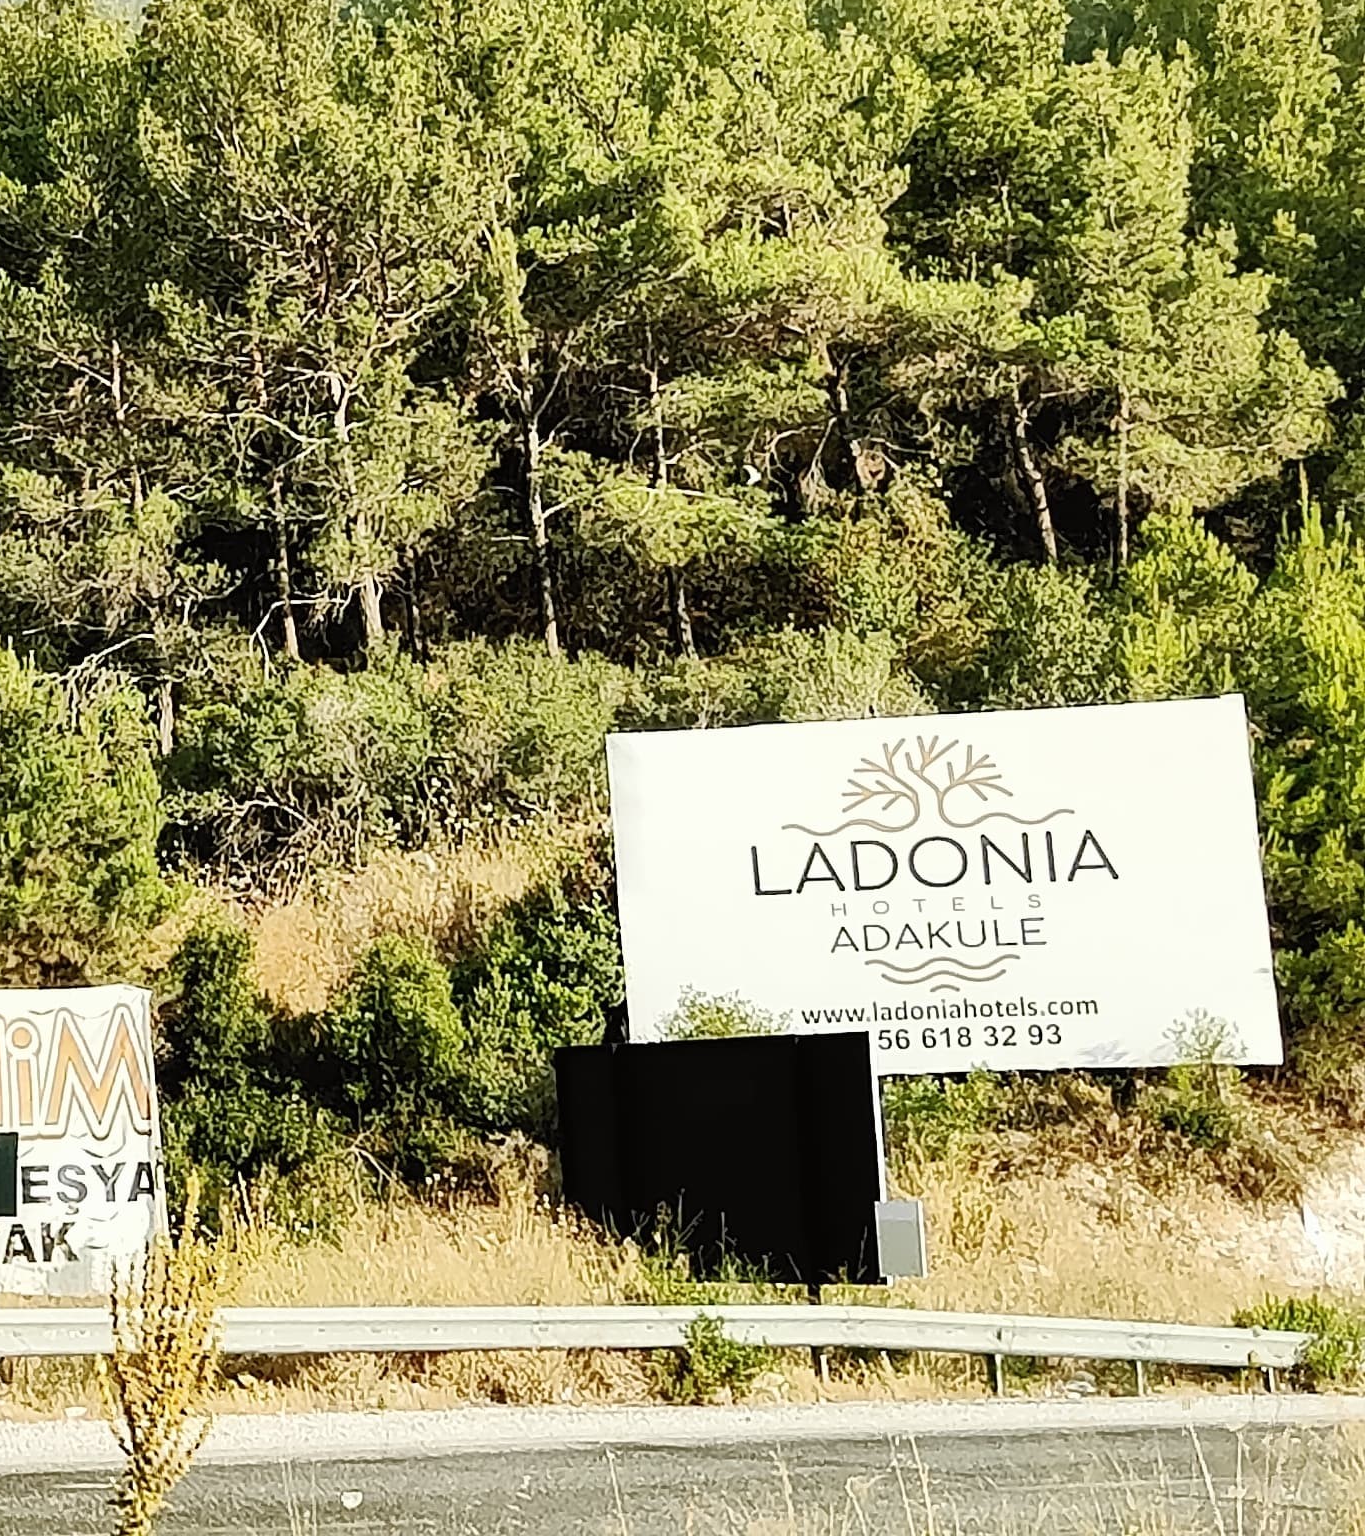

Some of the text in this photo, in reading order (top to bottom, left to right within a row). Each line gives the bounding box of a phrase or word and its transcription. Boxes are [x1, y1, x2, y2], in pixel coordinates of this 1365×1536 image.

[751, 830, 1119, 895] LADONIA
[831, 894, 1042, 916] HOTELS
[832, 917, 1047, 953] ADAKULE
[801, 997, 1099, 1024] www.ladoniahotels.com
[877, 1024, 1062, 1050] 56 618 32 93
